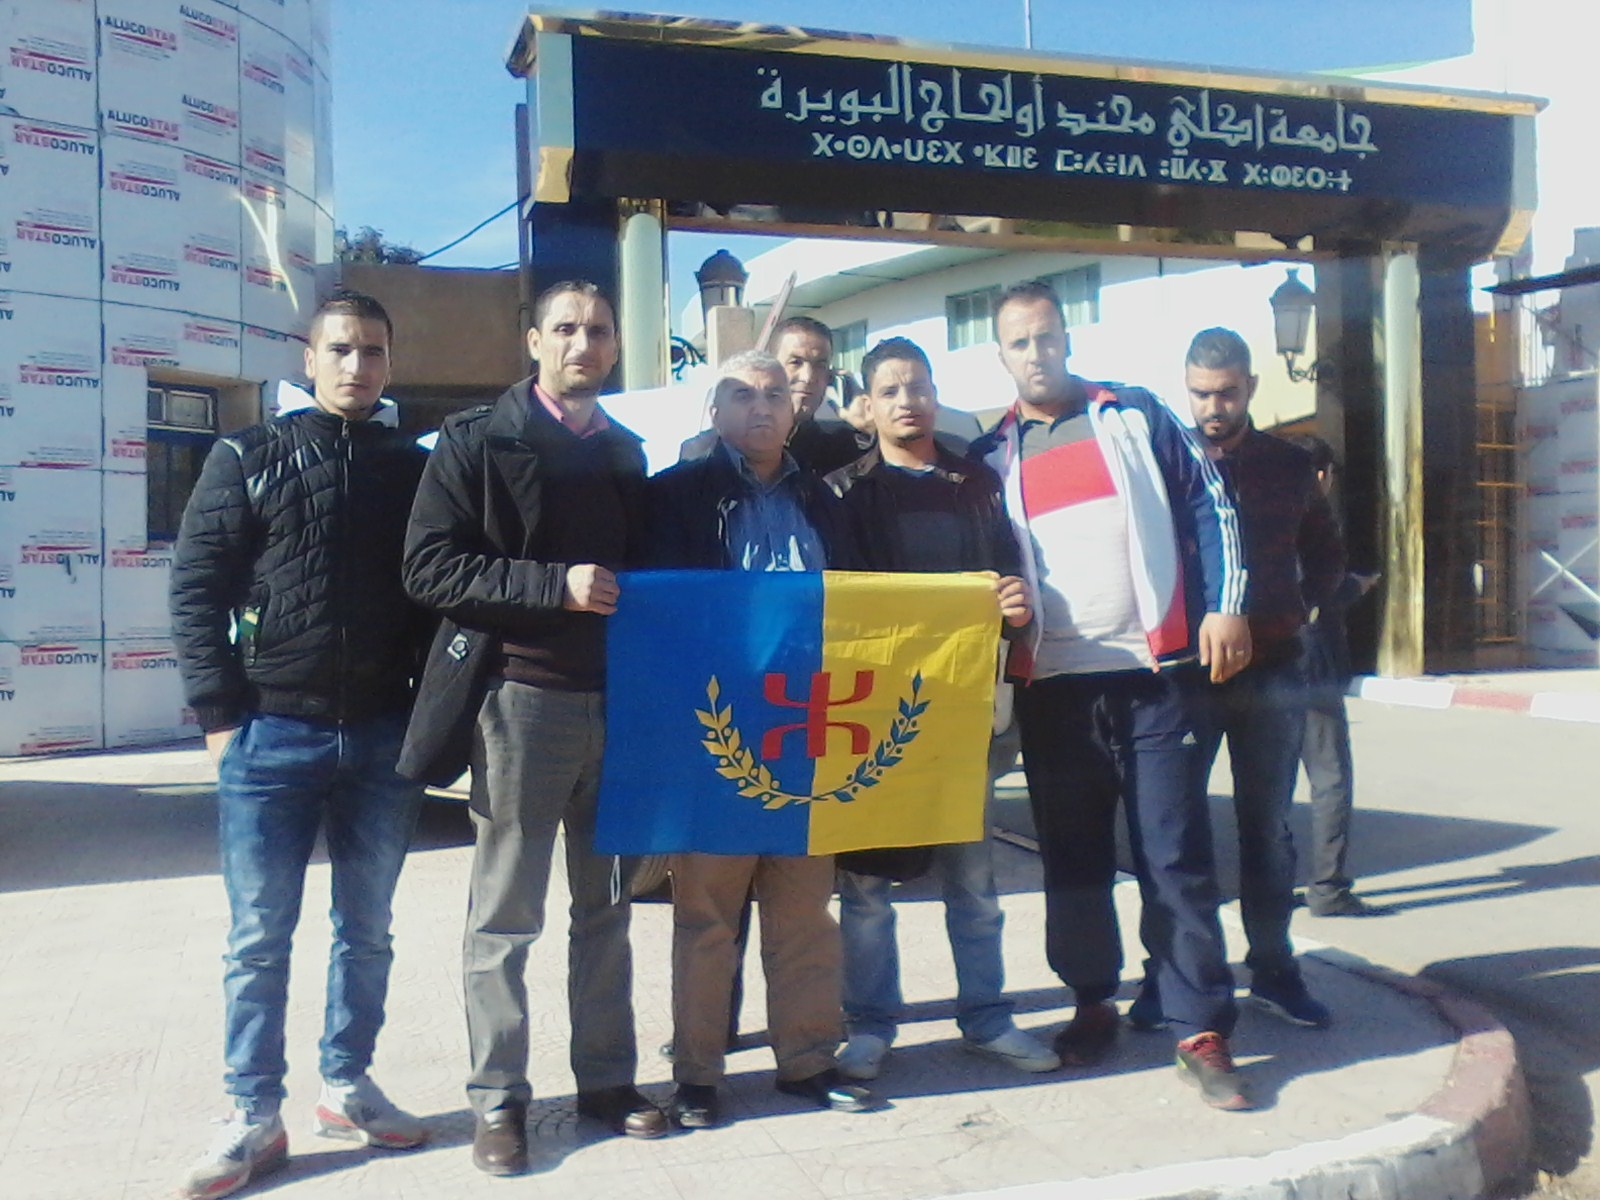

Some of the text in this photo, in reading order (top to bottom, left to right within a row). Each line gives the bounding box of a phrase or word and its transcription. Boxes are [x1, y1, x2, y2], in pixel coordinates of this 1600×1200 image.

[105, 16, 177, 43] ALUCOSTAR
[10, 56, 93, 82] ALUCOSTAR
[756, 61, 915, 125] البويرة
[107, 109, 179, 133] ALUCOSTAR
[1056, 94, 1156, 136] محند
[1269, 98, 1379, 159] جامعة
[14, 131, 95, 156] ALUCOSTAR
[109, 180, 180, 201] ALUCOSTAR
[16, 228, 97, 250] ALUCOSTAR
[111, 272, 180, 291] ALUCOSTAR
[20, 373, 99, 389] ALUCOSTAR
[112, 446, 147, 458] STAR
[21, 553, 100, 565] ALOSTAR
[112, 557, 172, 568] LUCOSTAR
[21, 653, 98, 666] ALUCOSTAR
